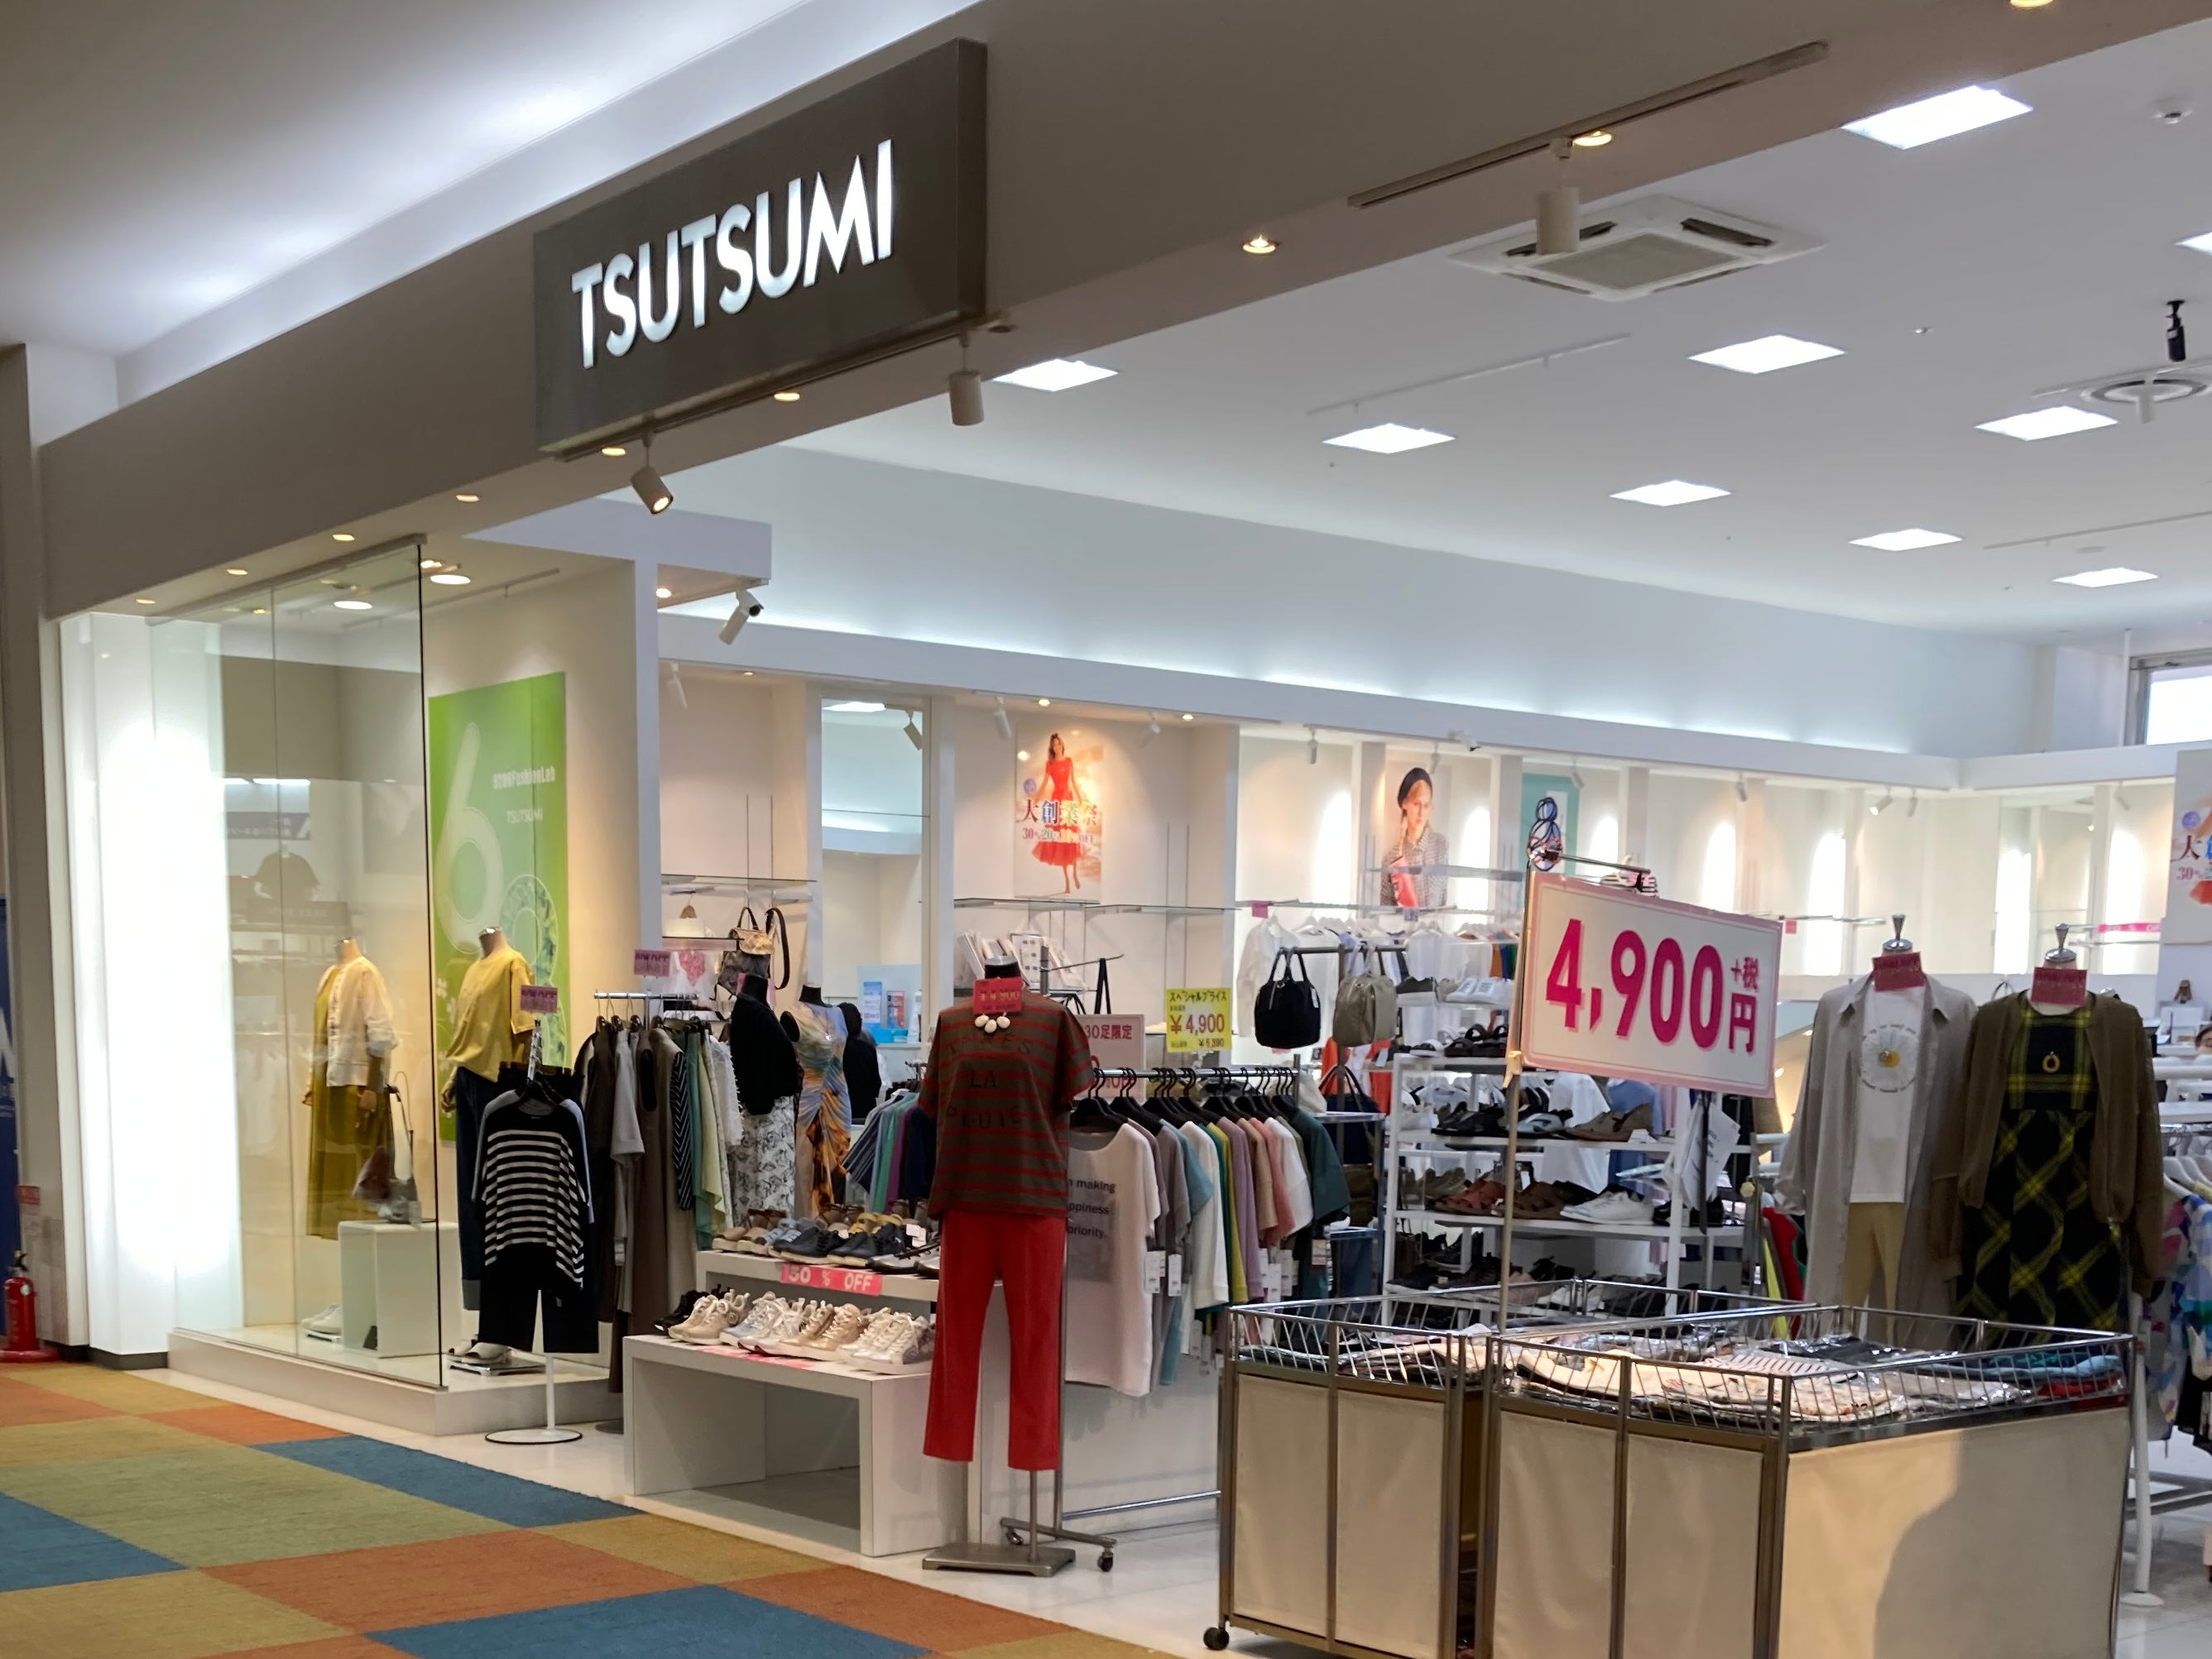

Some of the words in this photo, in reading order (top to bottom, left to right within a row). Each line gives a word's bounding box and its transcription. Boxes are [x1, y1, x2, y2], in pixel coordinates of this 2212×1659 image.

[571, 138, 892, 369] TSUTSUMI
[1545, 918, 1725, 1050] 4,900
[1728, 993, 1758, 1053] 円
[1077, 1179, 1116, 1194] making
[843, 1272, 873, 1292] OFF
